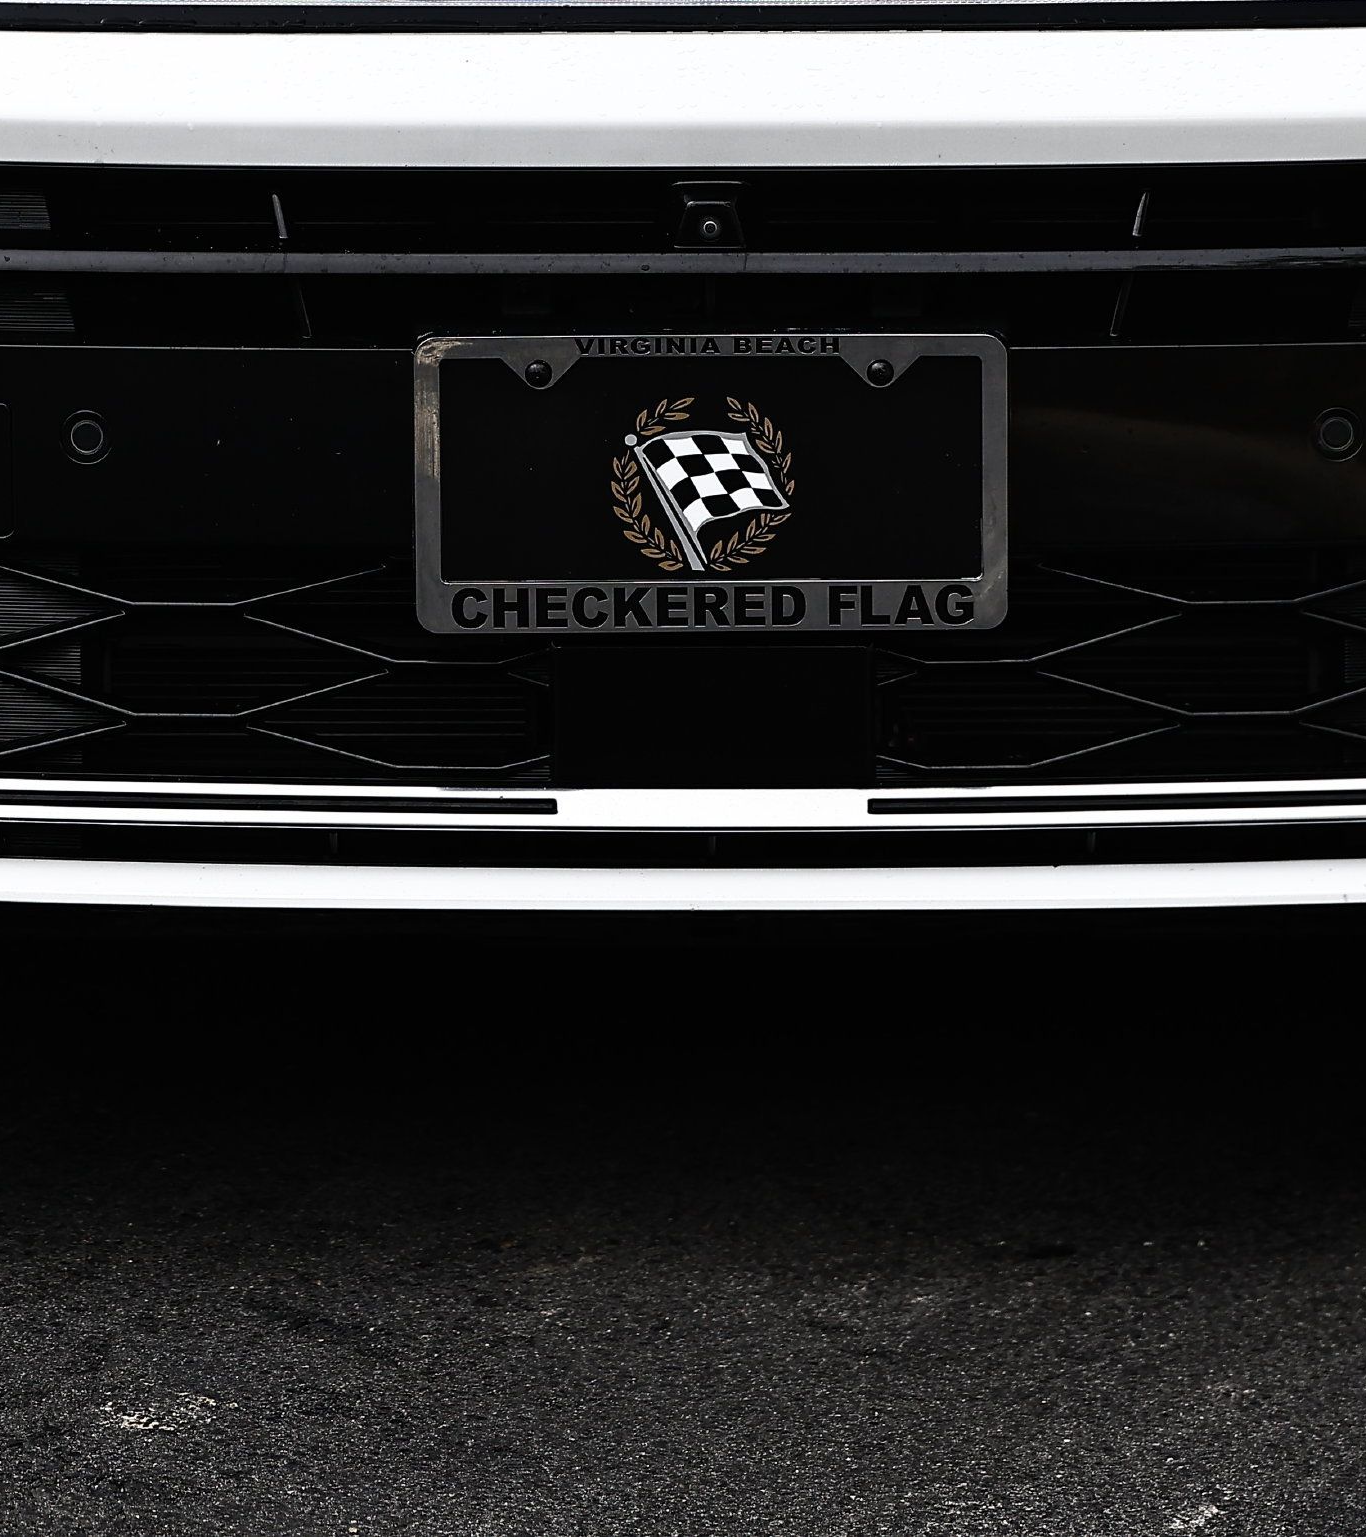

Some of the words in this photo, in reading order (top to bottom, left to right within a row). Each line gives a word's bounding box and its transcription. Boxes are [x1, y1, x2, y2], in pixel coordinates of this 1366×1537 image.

[574, 336, 721, 355] VIRGINIA
[732, 336, 840, 355] BEACH
[451, 585, 807, 630] CHECKERED
[828, 584, 974, 627] FLAG
